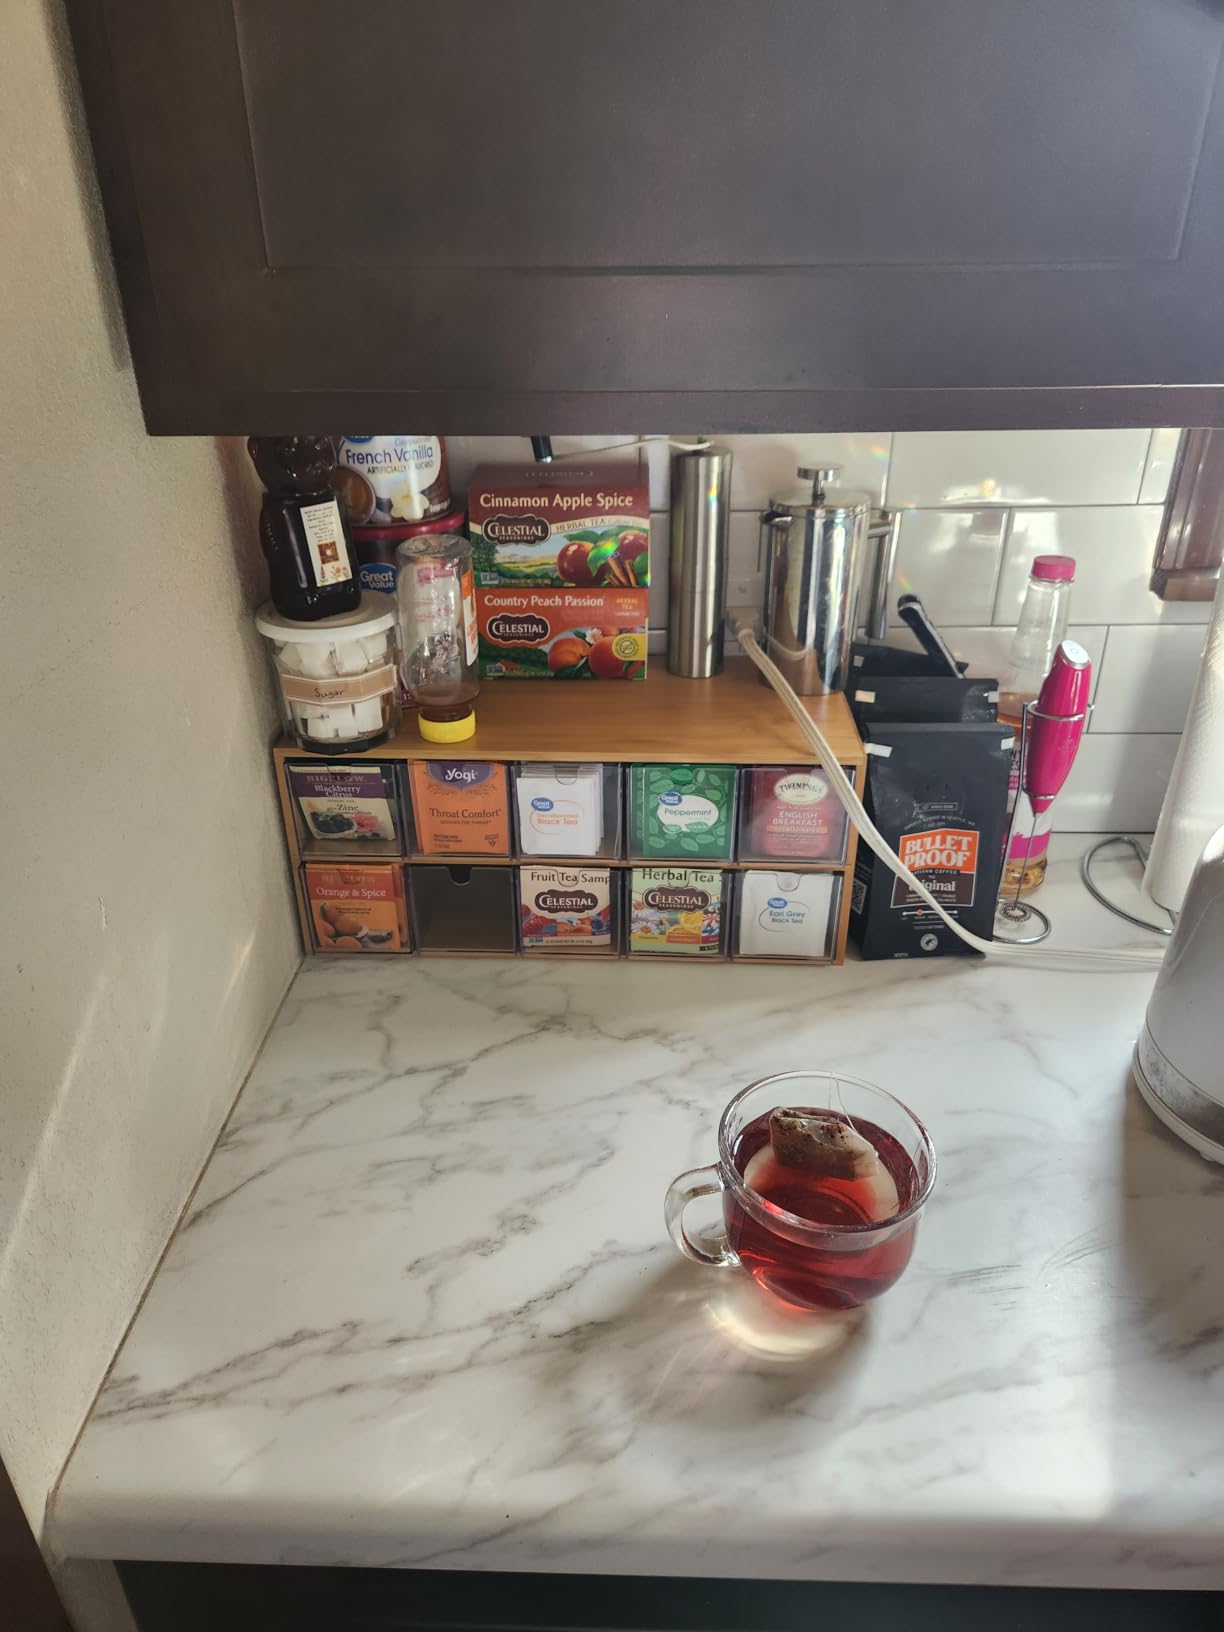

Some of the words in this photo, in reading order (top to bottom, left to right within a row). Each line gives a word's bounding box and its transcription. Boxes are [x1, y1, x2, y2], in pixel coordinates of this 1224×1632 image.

[346, 449, 391, 464] French
[394, 446, 433, 462] Vanilla
[480, 494, 548, 508] Cinnamon
[553, 493, 592, 510] Apple
[597, 493, 633, 510] Spice
[487, 522, 545, 537] CELESTIAL
[555, 522, 586, 531] HERBAL
[591, 518, 605, 526] TEA
[360, 571, 393, 582] Great
[369, 580, 394, 588] Value
[484, 595, 528, 609] Country
[531, 595, 561, 607] Peach
[565, 595, 604, 607] Passion
[492, 621, 545, 636] CELESTIAL
[314, 687, 344, 698] Sugar
[314, 784, 361, 794] Blackberry
[337, 803, 359, 811] Zinc
[664, 808, 712, 816] Peppermint
[429, 808, 460, 818] Throat
[462, 808, 499, 819] Comfort
[780, 811, 818, 819] ENGLISH
[773, 818, 824, 826] BREAKFAST
[905, 835, 973, 854] BULLET
[904, 849, 971, 867] PROOF
[531, 871, 556, 881] Fruit
[559, 872, 578, 882] Tea
[642, 868, 687, 881] Herbal
[692, 871, 714, 882] Tea
[316, 887, 350, 898] Orange
[352, 889, 360, 897] &
[361, 888, 387, 899] Spice
[648, 892, 704, 905] CELESTIAL
[539, 895, 594, 908] CELESTIAL
